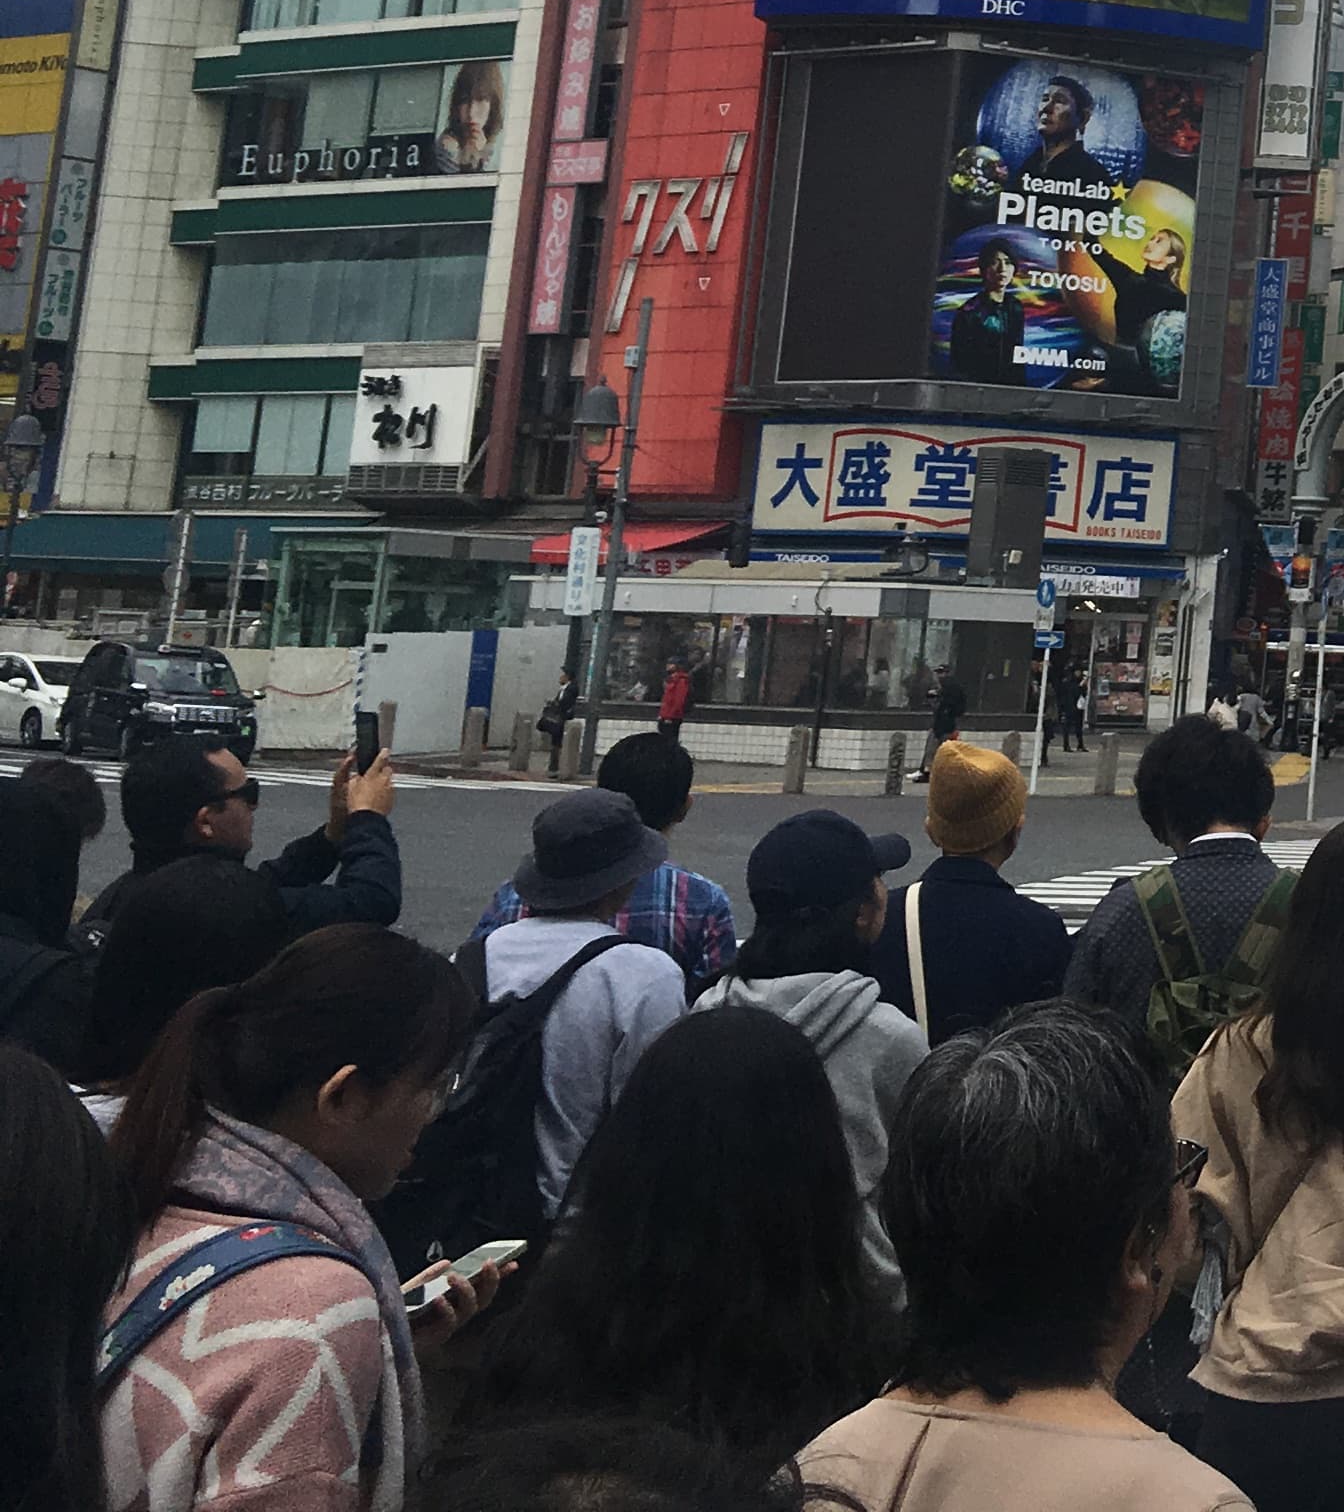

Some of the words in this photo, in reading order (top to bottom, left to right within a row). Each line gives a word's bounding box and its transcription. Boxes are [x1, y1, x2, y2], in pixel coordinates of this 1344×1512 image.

[982, 0, 1025, 16] DHC
[239, 136, 420, 183] Euphoria
[1022, 172, 1111, 201] teamLab
[997, 191, 1146, 241] Planets
[1040, 236, 1103, 255] TOKYO
[1029, 270, 1107, 294] TOYOSU
[1013, 345, 1106, 371] DMM.com
[770, 441, 1154, 523] 大盛堂店
[1086, 525, 1116, 538] BOOKS
[776, 552, 830, 564] TAISEIDO
